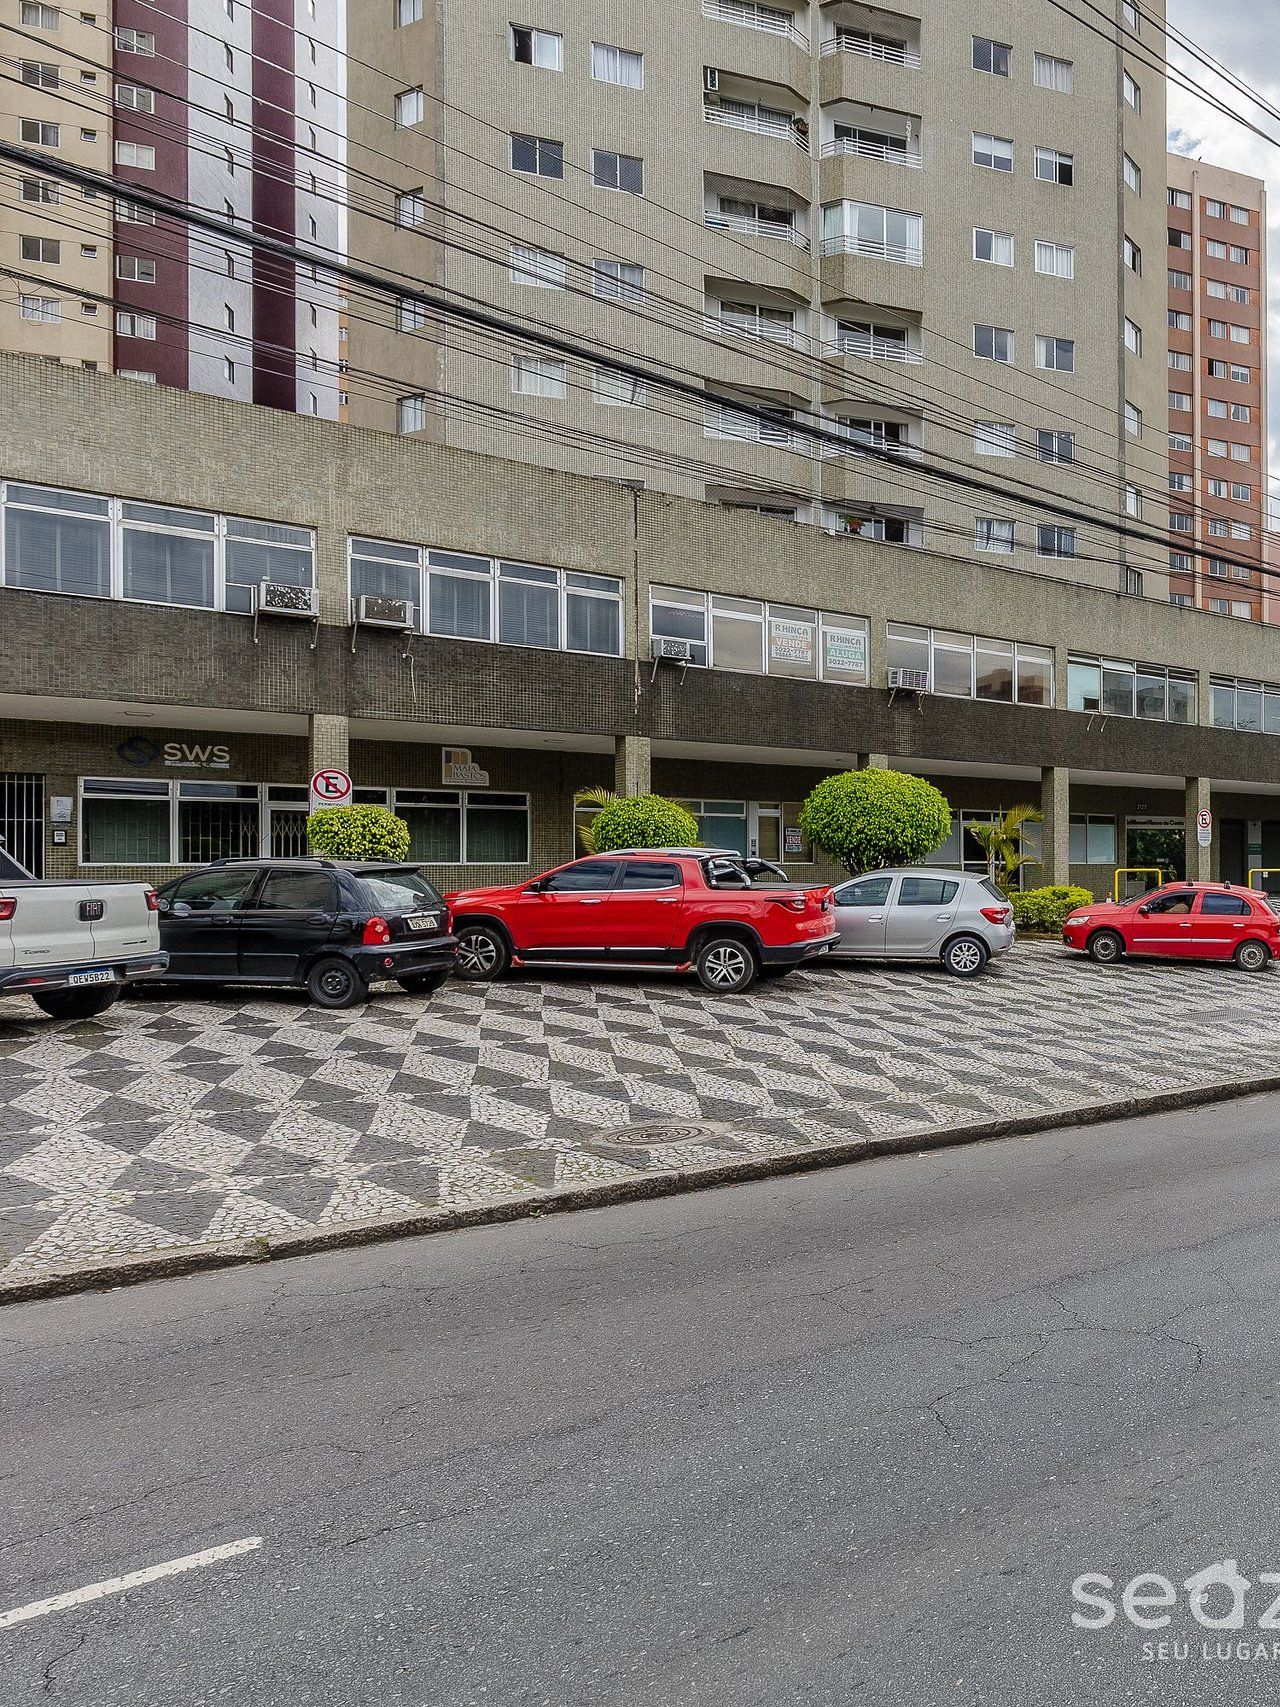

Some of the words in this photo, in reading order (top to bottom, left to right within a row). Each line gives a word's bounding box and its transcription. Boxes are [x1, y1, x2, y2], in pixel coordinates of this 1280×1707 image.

[776, 638, 808, 649] VENDE
[829, 648, 862, 659] ALUGA
[828, 658, 863, 668] 3022-7787
[163, 743, 230, 762] SWS
[453, 764, 478, 772] MAIA
[453, 771, 487, 780] BASTOS
[86, 902, 102, 916] FIAT
[73, 971, 110, 984] QEW5B22
